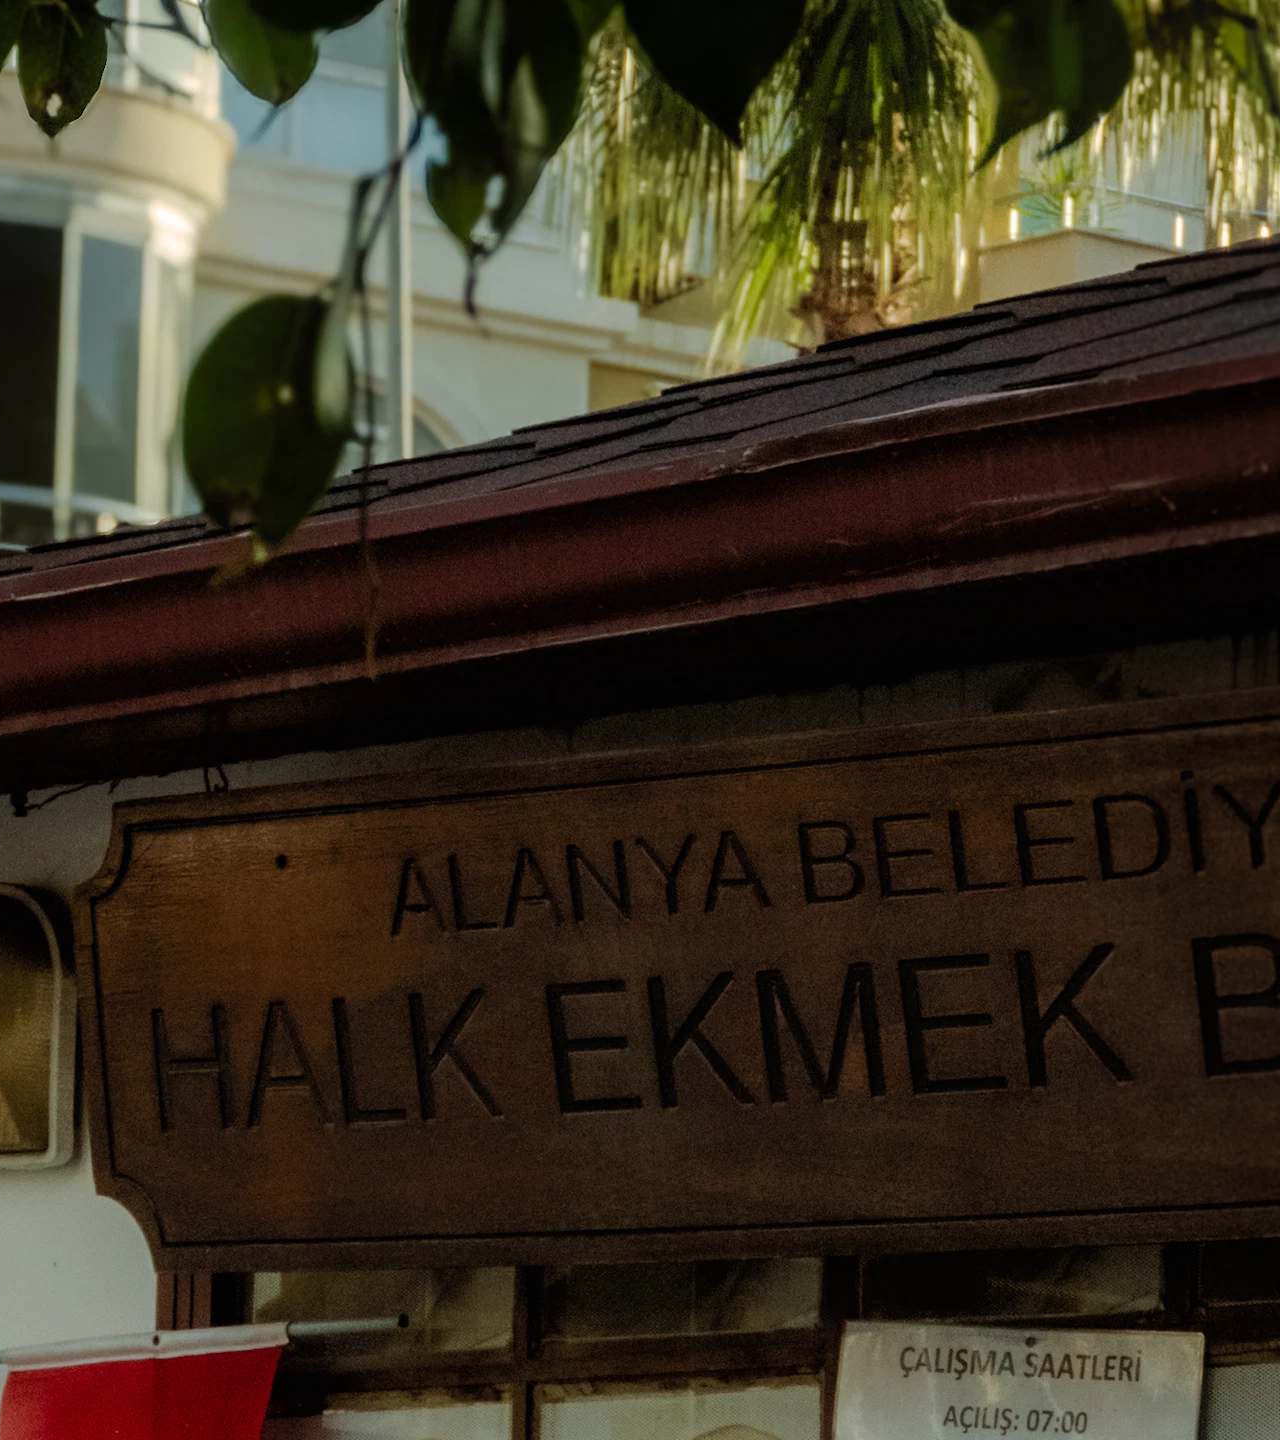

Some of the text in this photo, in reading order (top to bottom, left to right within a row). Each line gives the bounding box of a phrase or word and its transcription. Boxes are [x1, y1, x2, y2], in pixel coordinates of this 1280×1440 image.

[392, 830, 774, 936] ALANYA
[151, 988, 505, 1132] HALK
[545, 942, 1134, 1117] EKMEK
[899, 1345, 1142, 1383] ÇALIŞMA SAATLERİ
[942, 1404, 1088, 1436] AÇILIŞ: 07:00
